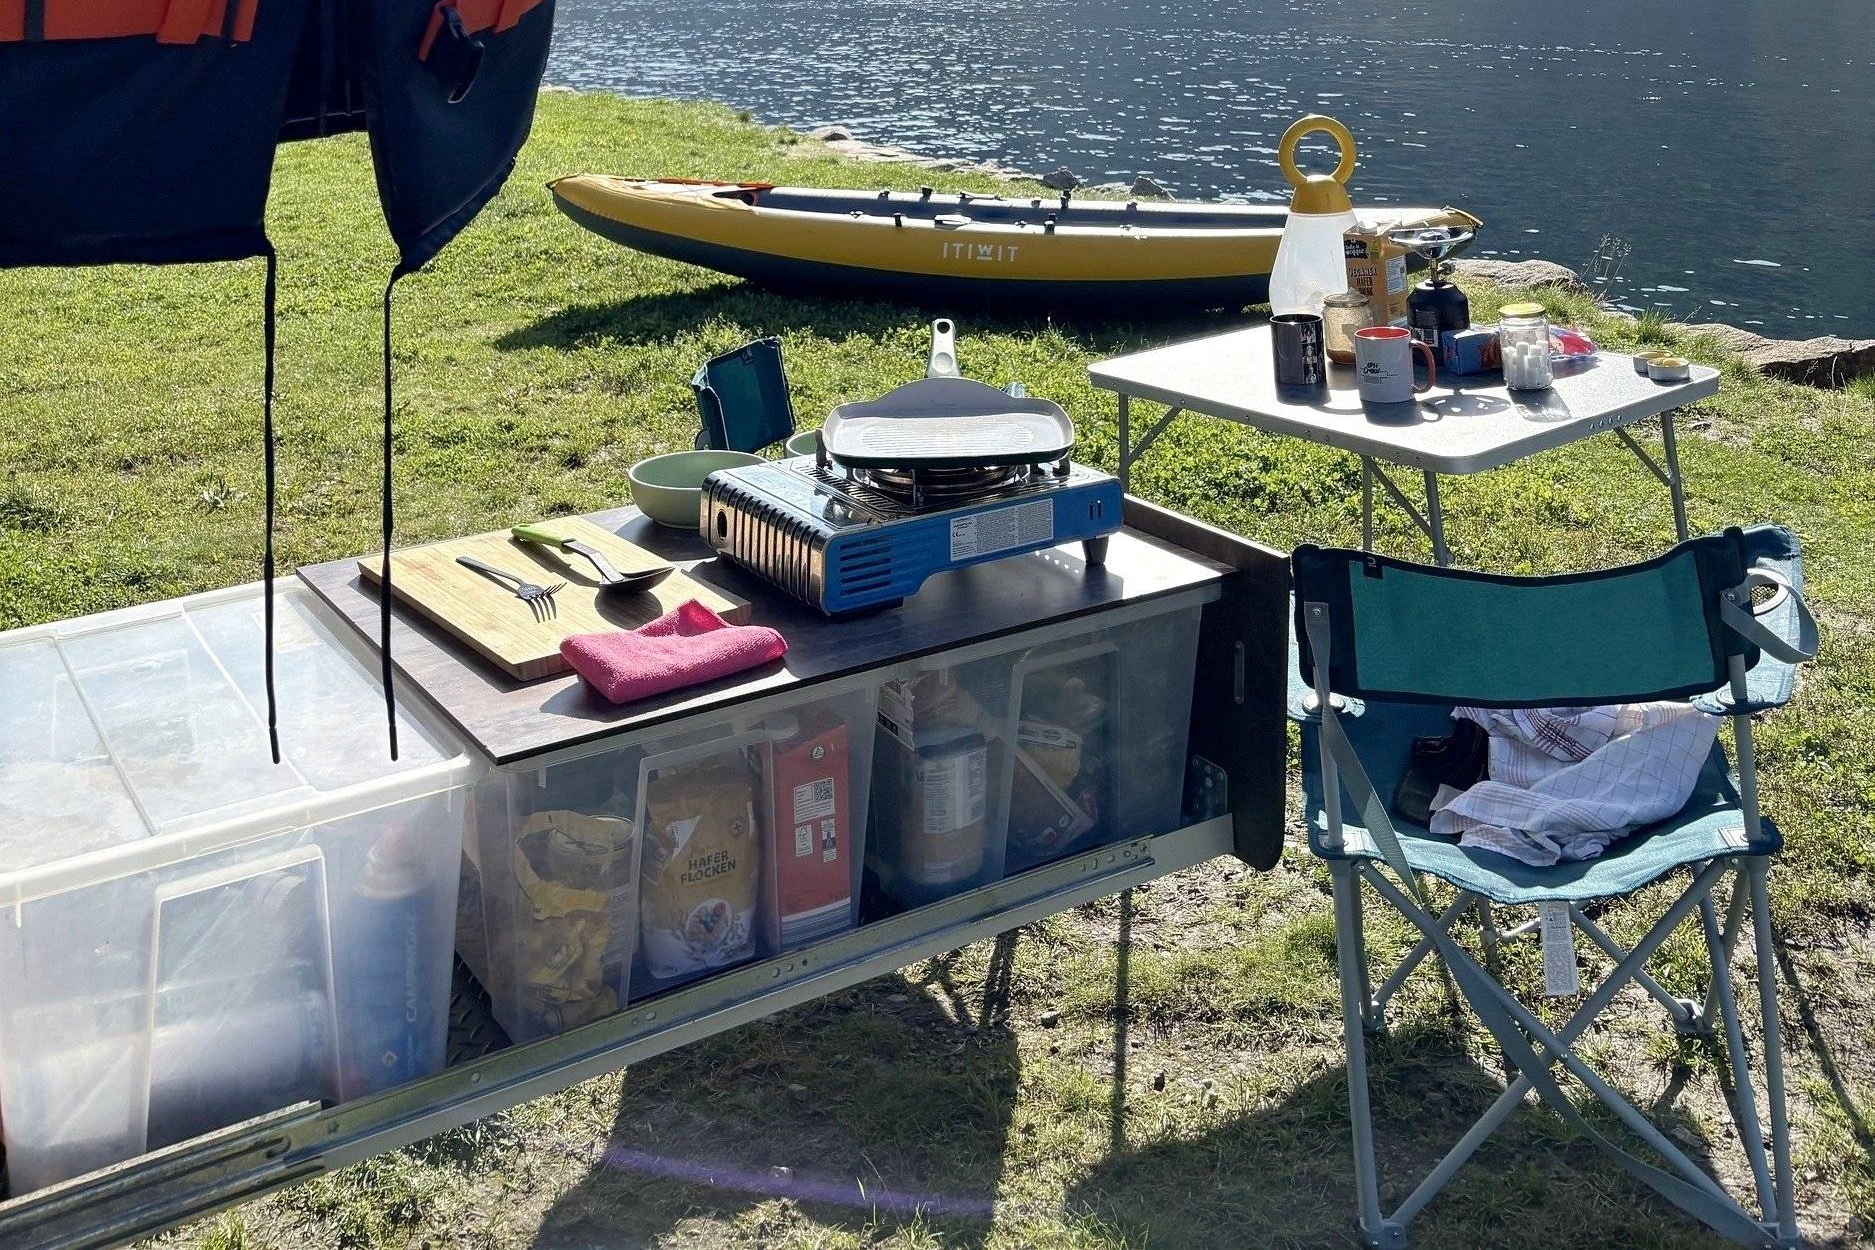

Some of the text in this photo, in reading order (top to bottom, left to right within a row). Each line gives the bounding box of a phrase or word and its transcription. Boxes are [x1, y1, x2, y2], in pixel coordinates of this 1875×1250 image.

[943, 242, 1019, 262] ITIWIT
[1348, 267, 1378, 278] VEGANER
[1356, 276, 1373, 287] HAFER
[688, 850, 729, 871] HAFER
[680, 859, 737, 885] FLOCKEN
